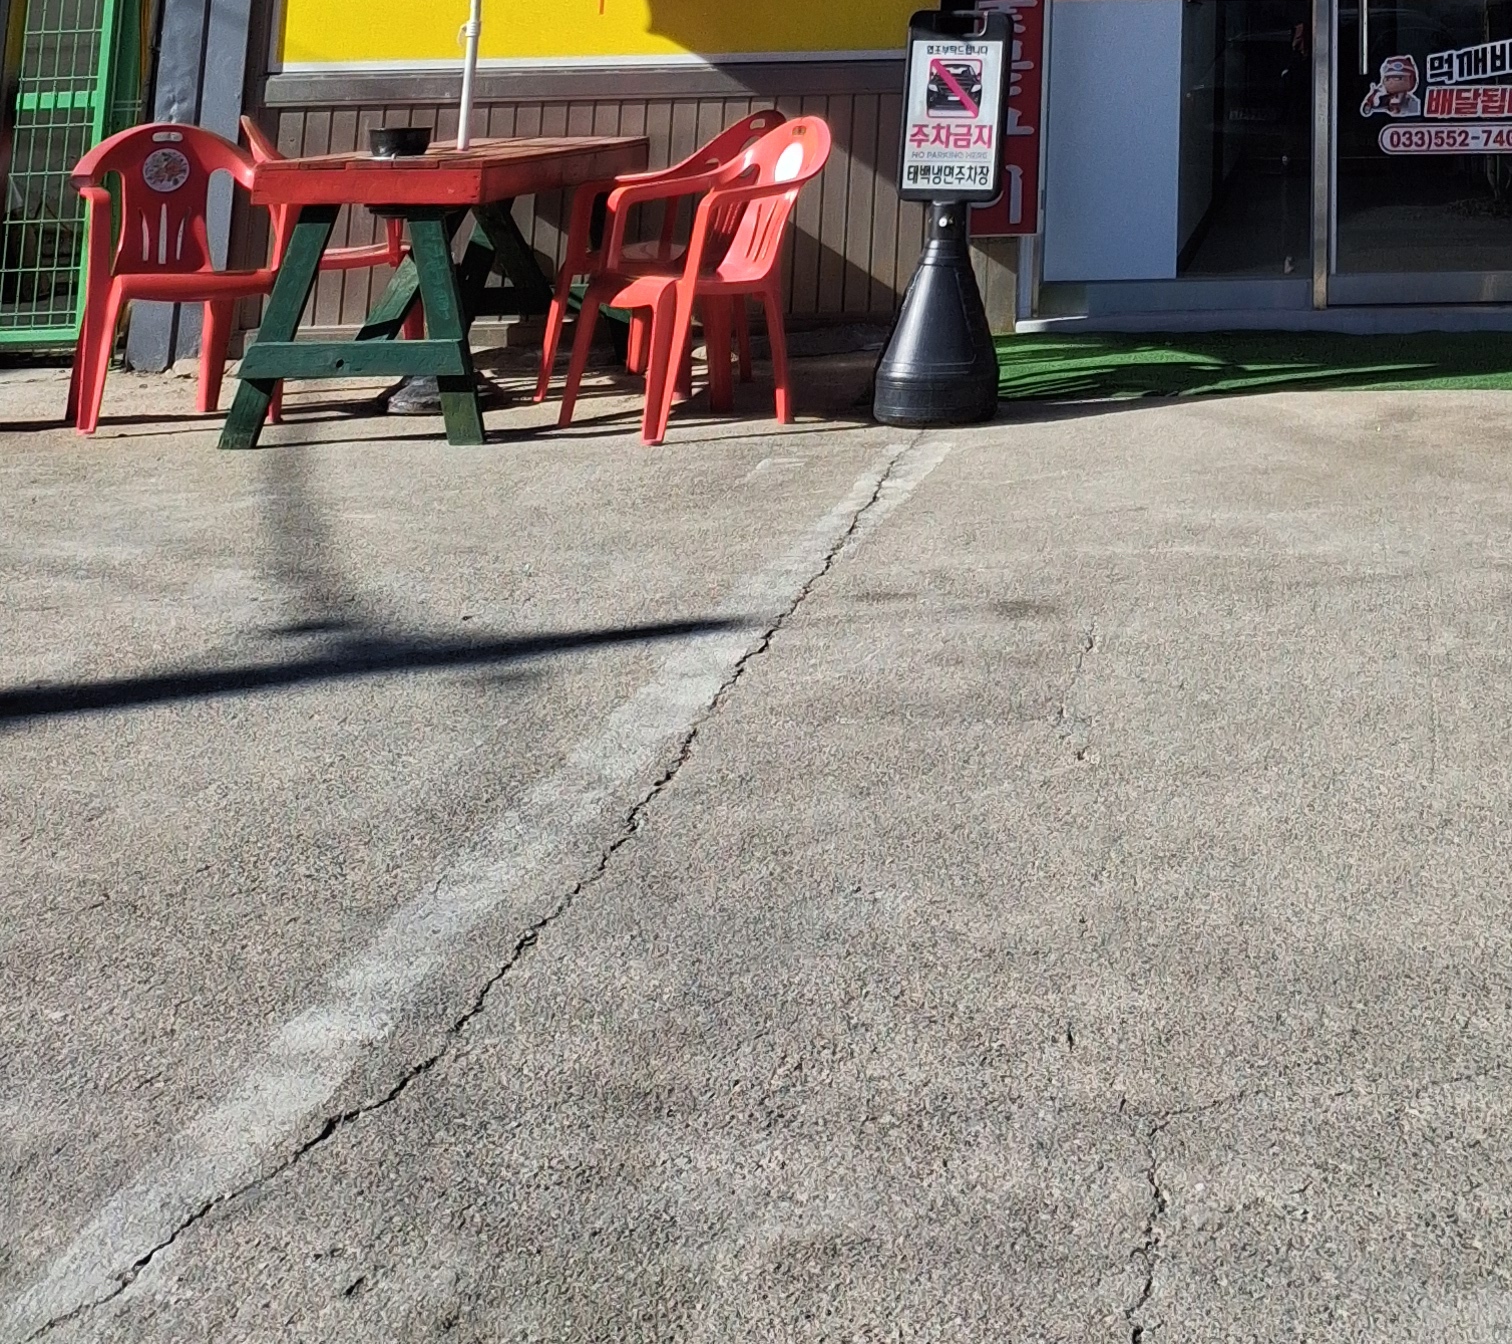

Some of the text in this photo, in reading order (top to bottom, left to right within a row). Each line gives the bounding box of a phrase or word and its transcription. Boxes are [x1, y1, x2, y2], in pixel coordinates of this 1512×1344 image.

[909, 123, 993, 149] 주차금지
[927, 151, 963, 159] PARKING
[907, 165, 989, 185] 태백냉면주차장
